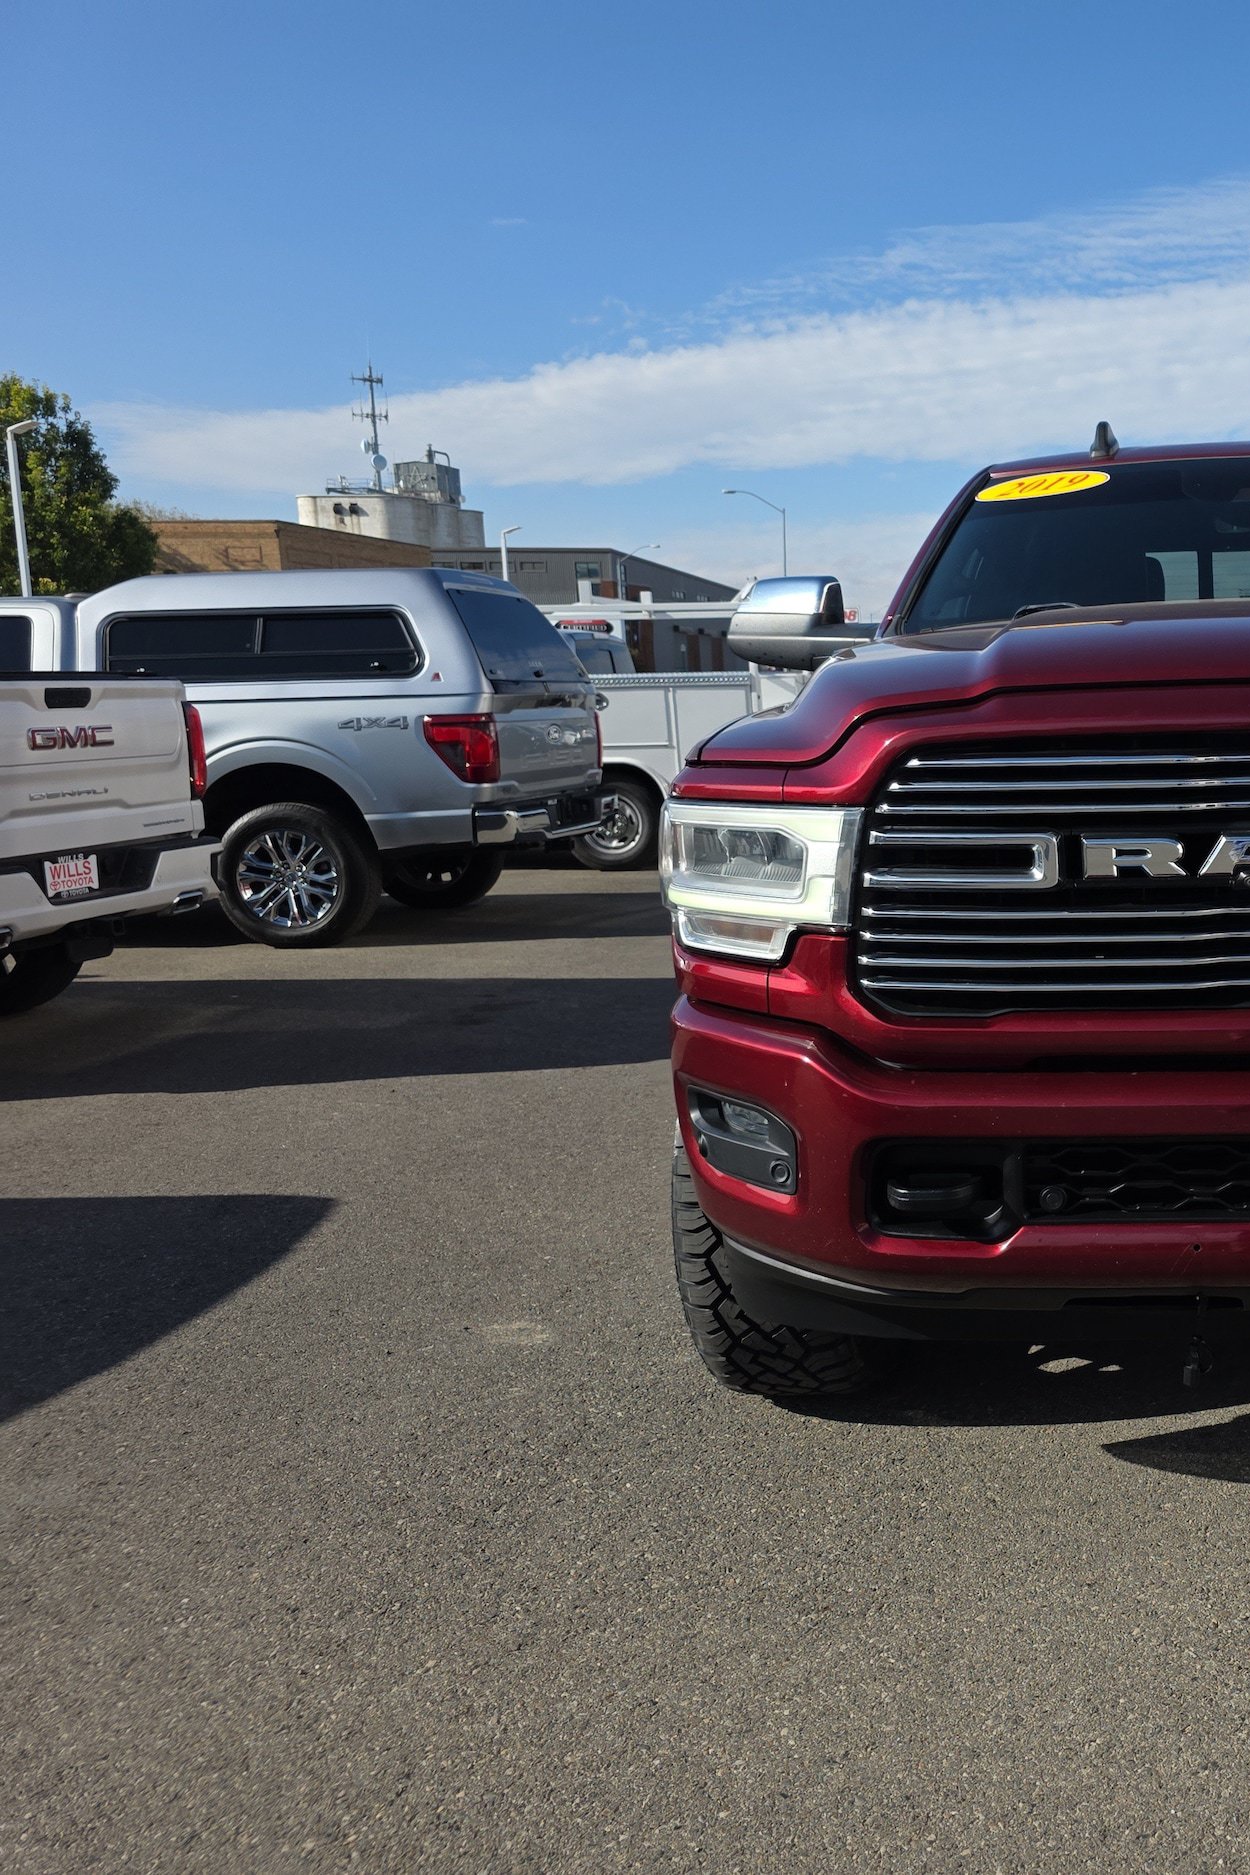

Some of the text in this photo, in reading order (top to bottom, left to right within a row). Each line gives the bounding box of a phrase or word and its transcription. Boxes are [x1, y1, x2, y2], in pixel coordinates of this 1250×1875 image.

[995, 473, 1090, 498] 2019
[27, 725, 114, 751] GMC
[49, 861, 92, 880] WILLS
[60, 875, 95, 889] TOYOTA
